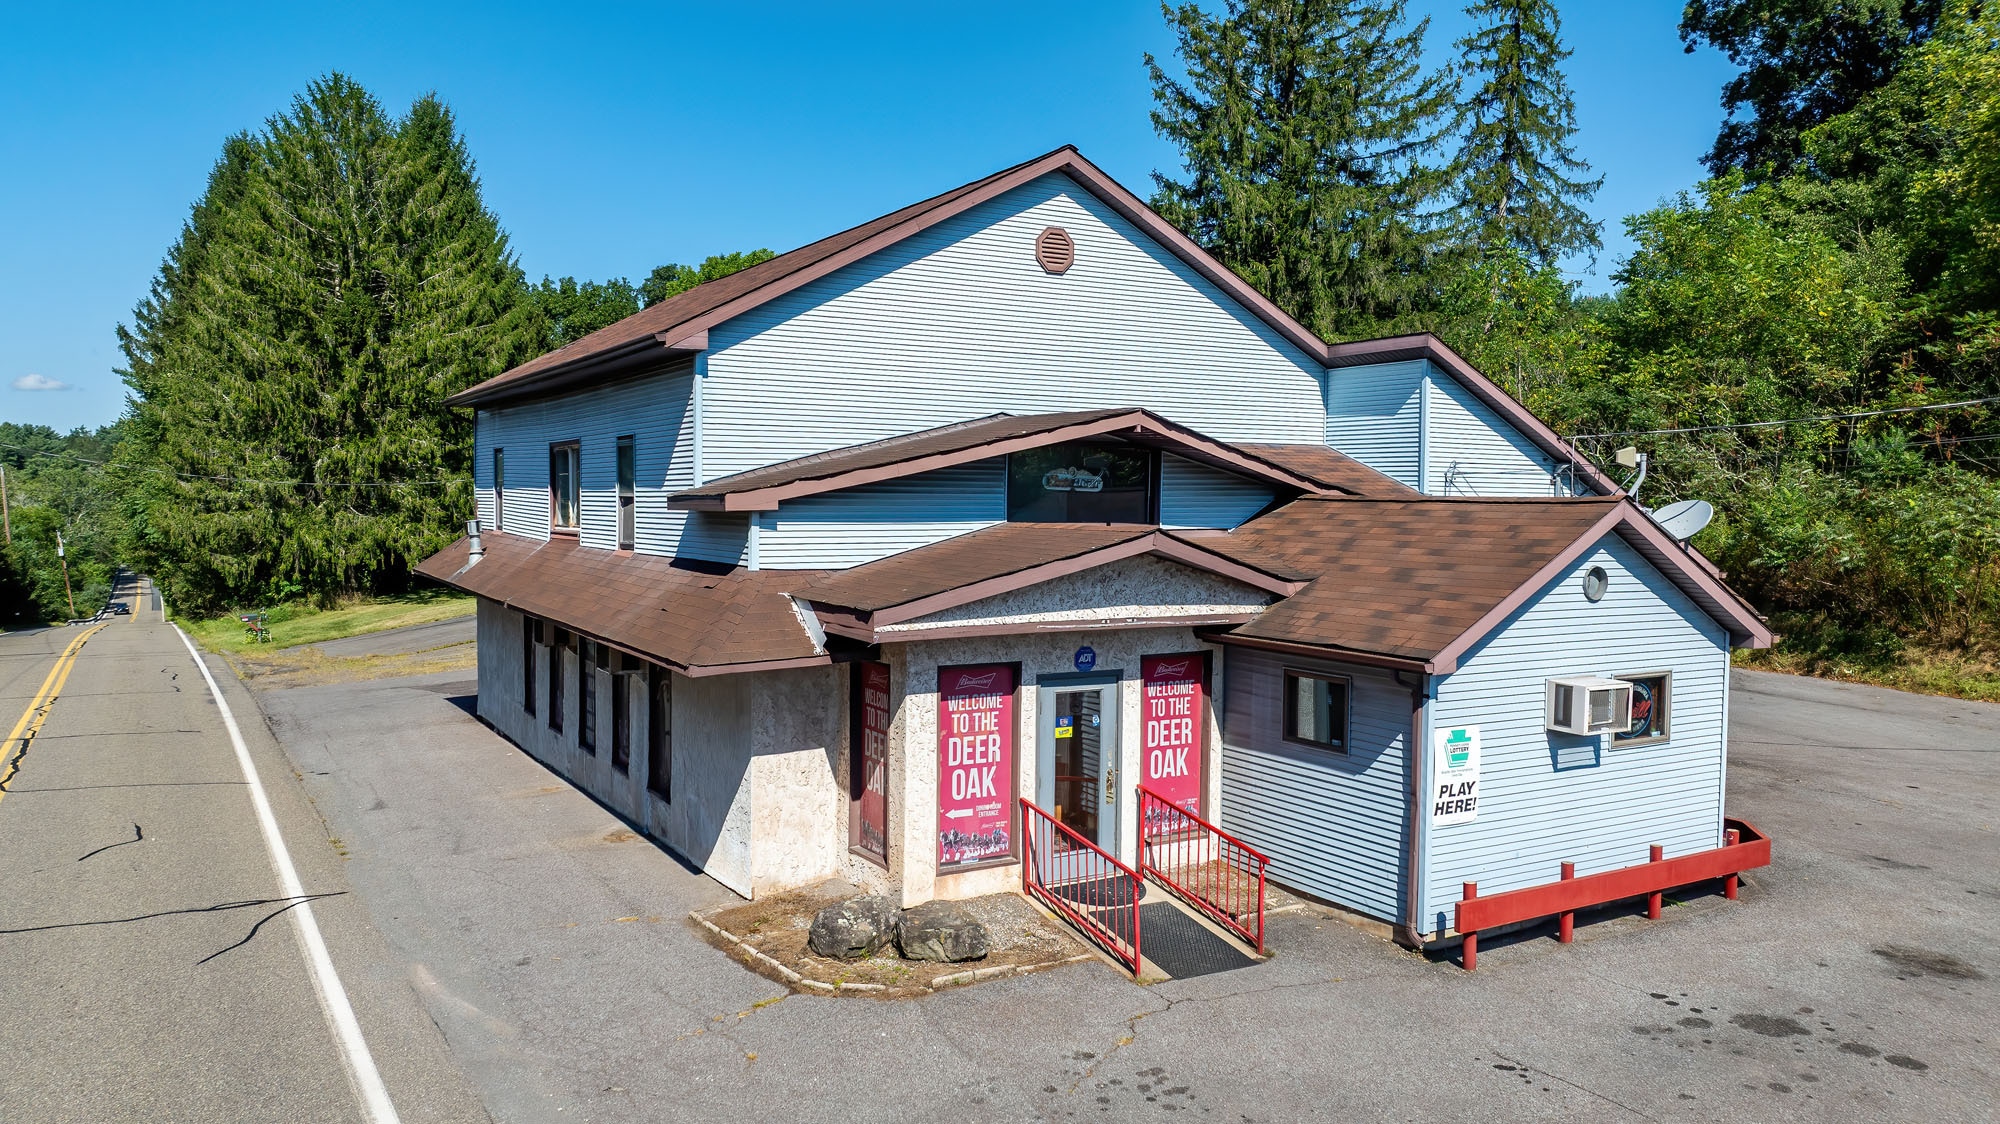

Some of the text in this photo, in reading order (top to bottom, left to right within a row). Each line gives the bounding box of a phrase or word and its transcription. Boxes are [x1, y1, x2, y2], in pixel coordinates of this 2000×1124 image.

[1078, 653, 1093, 663] ADT
[865, 687, 889, 711] WELCOM
[1147, 679, 1195, 698] WELCOME
[947, 692, 1003, 712] WELCOME
[1150, 696, 1191, 717] TO THE
[866, 706, 889, 730] TO TH
[951, 710, 999, 734] TO THE
[1147, 717, 1193, 748] DEER
[864, 728, 887, 763] DEE
[948, 734, 1001, 767] DEER
[1449, 746, 1470, 754] LOTTERY
[1150, 747, 1189, 780] OAK
[866, 760, 885, 798] OA
[951, 765, 997, 801] OAK
[1438, 780, 1477, 799] PLAY
[978, 809, 1000, 818] ENTRANCE
[1433, 797, 1477, 817] HERE!
